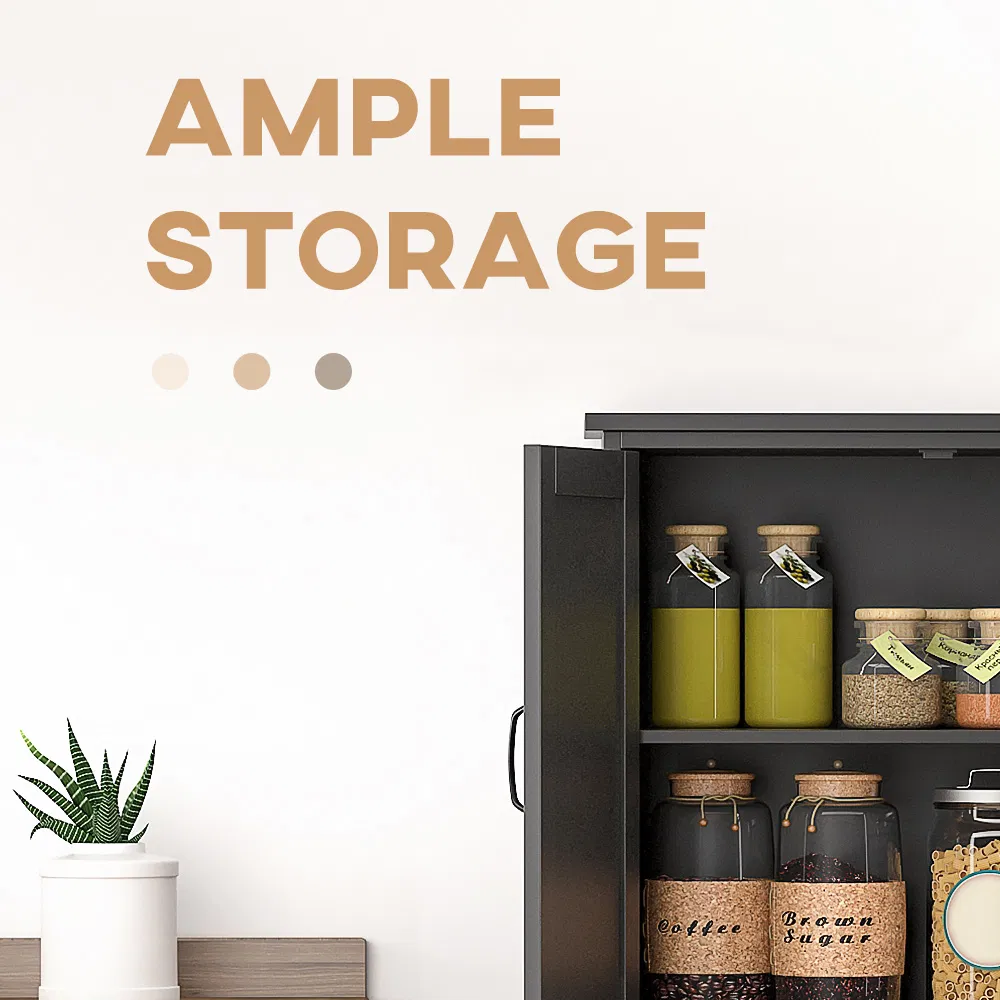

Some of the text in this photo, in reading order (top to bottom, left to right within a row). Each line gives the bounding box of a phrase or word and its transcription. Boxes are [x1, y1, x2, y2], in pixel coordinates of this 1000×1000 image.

[781, 910, 875, 927] Brown
[657, 919, 743, 936] Coffee
[783, 928, 872, 947] Sugar
